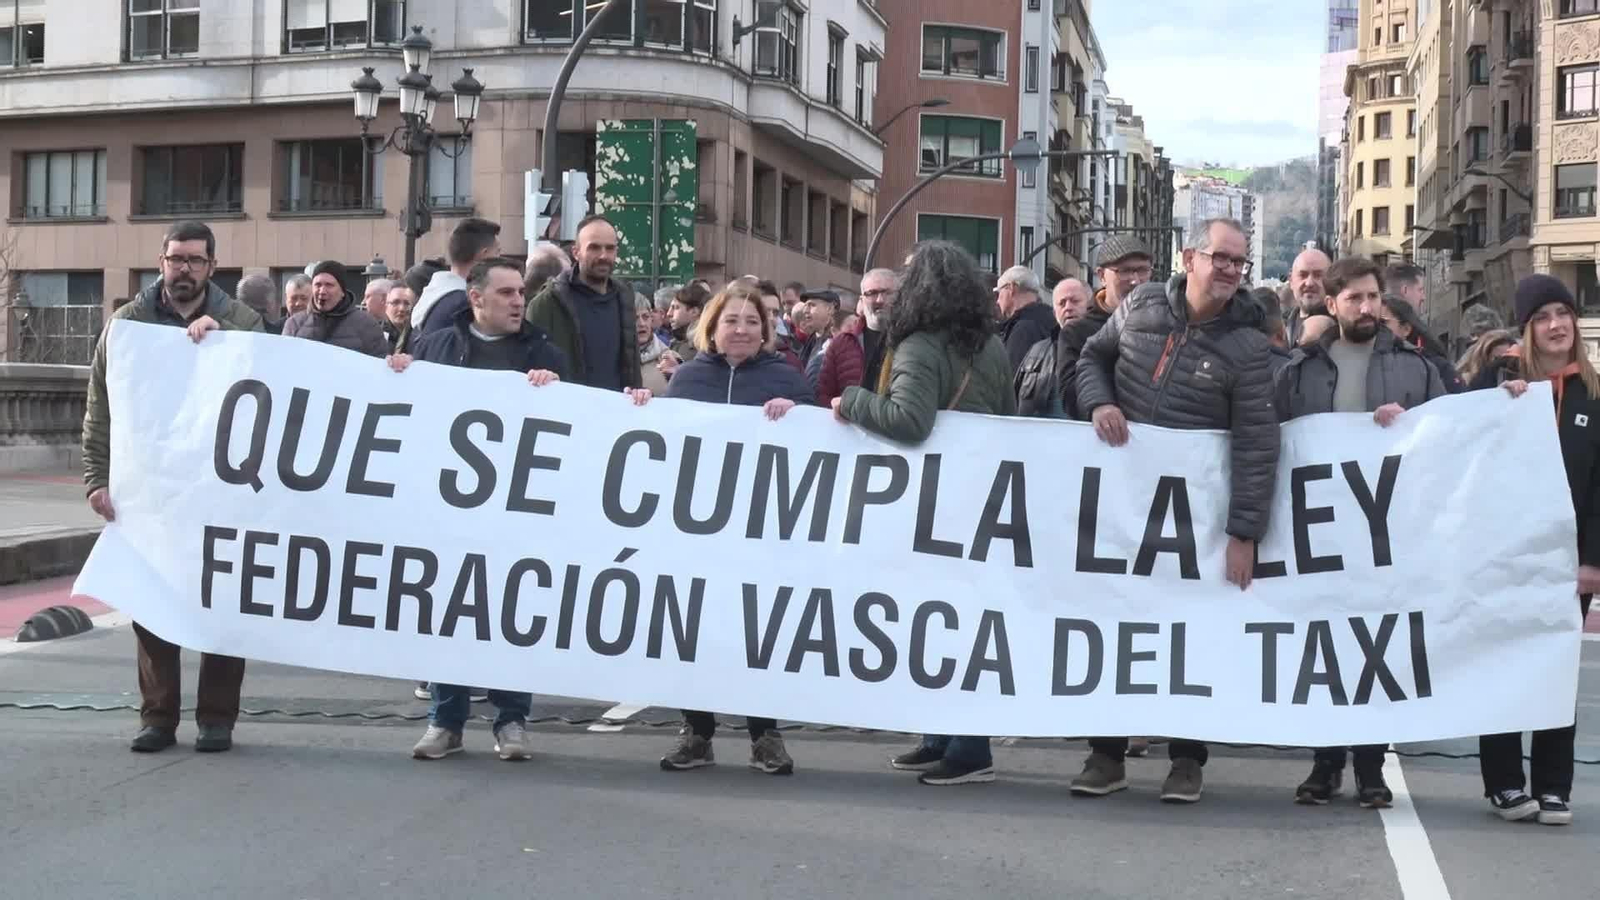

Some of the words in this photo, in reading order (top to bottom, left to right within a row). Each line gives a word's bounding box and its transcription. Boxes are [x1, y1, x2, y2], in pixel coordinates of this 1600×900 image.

[213, 379, 413, 499] QUE
[438, 409, 572, 516] SE
[602, 429, 1034, 569] CUMPLA
[1075, 466, 1201, 581] LA
[201, 525, 706, 663] FEDERACIÓN
[741, 582, 1016, 696] VASCA
[1051, 617, 1212, 698] DEL
[1244, 610, 1433, 706] TAXI
